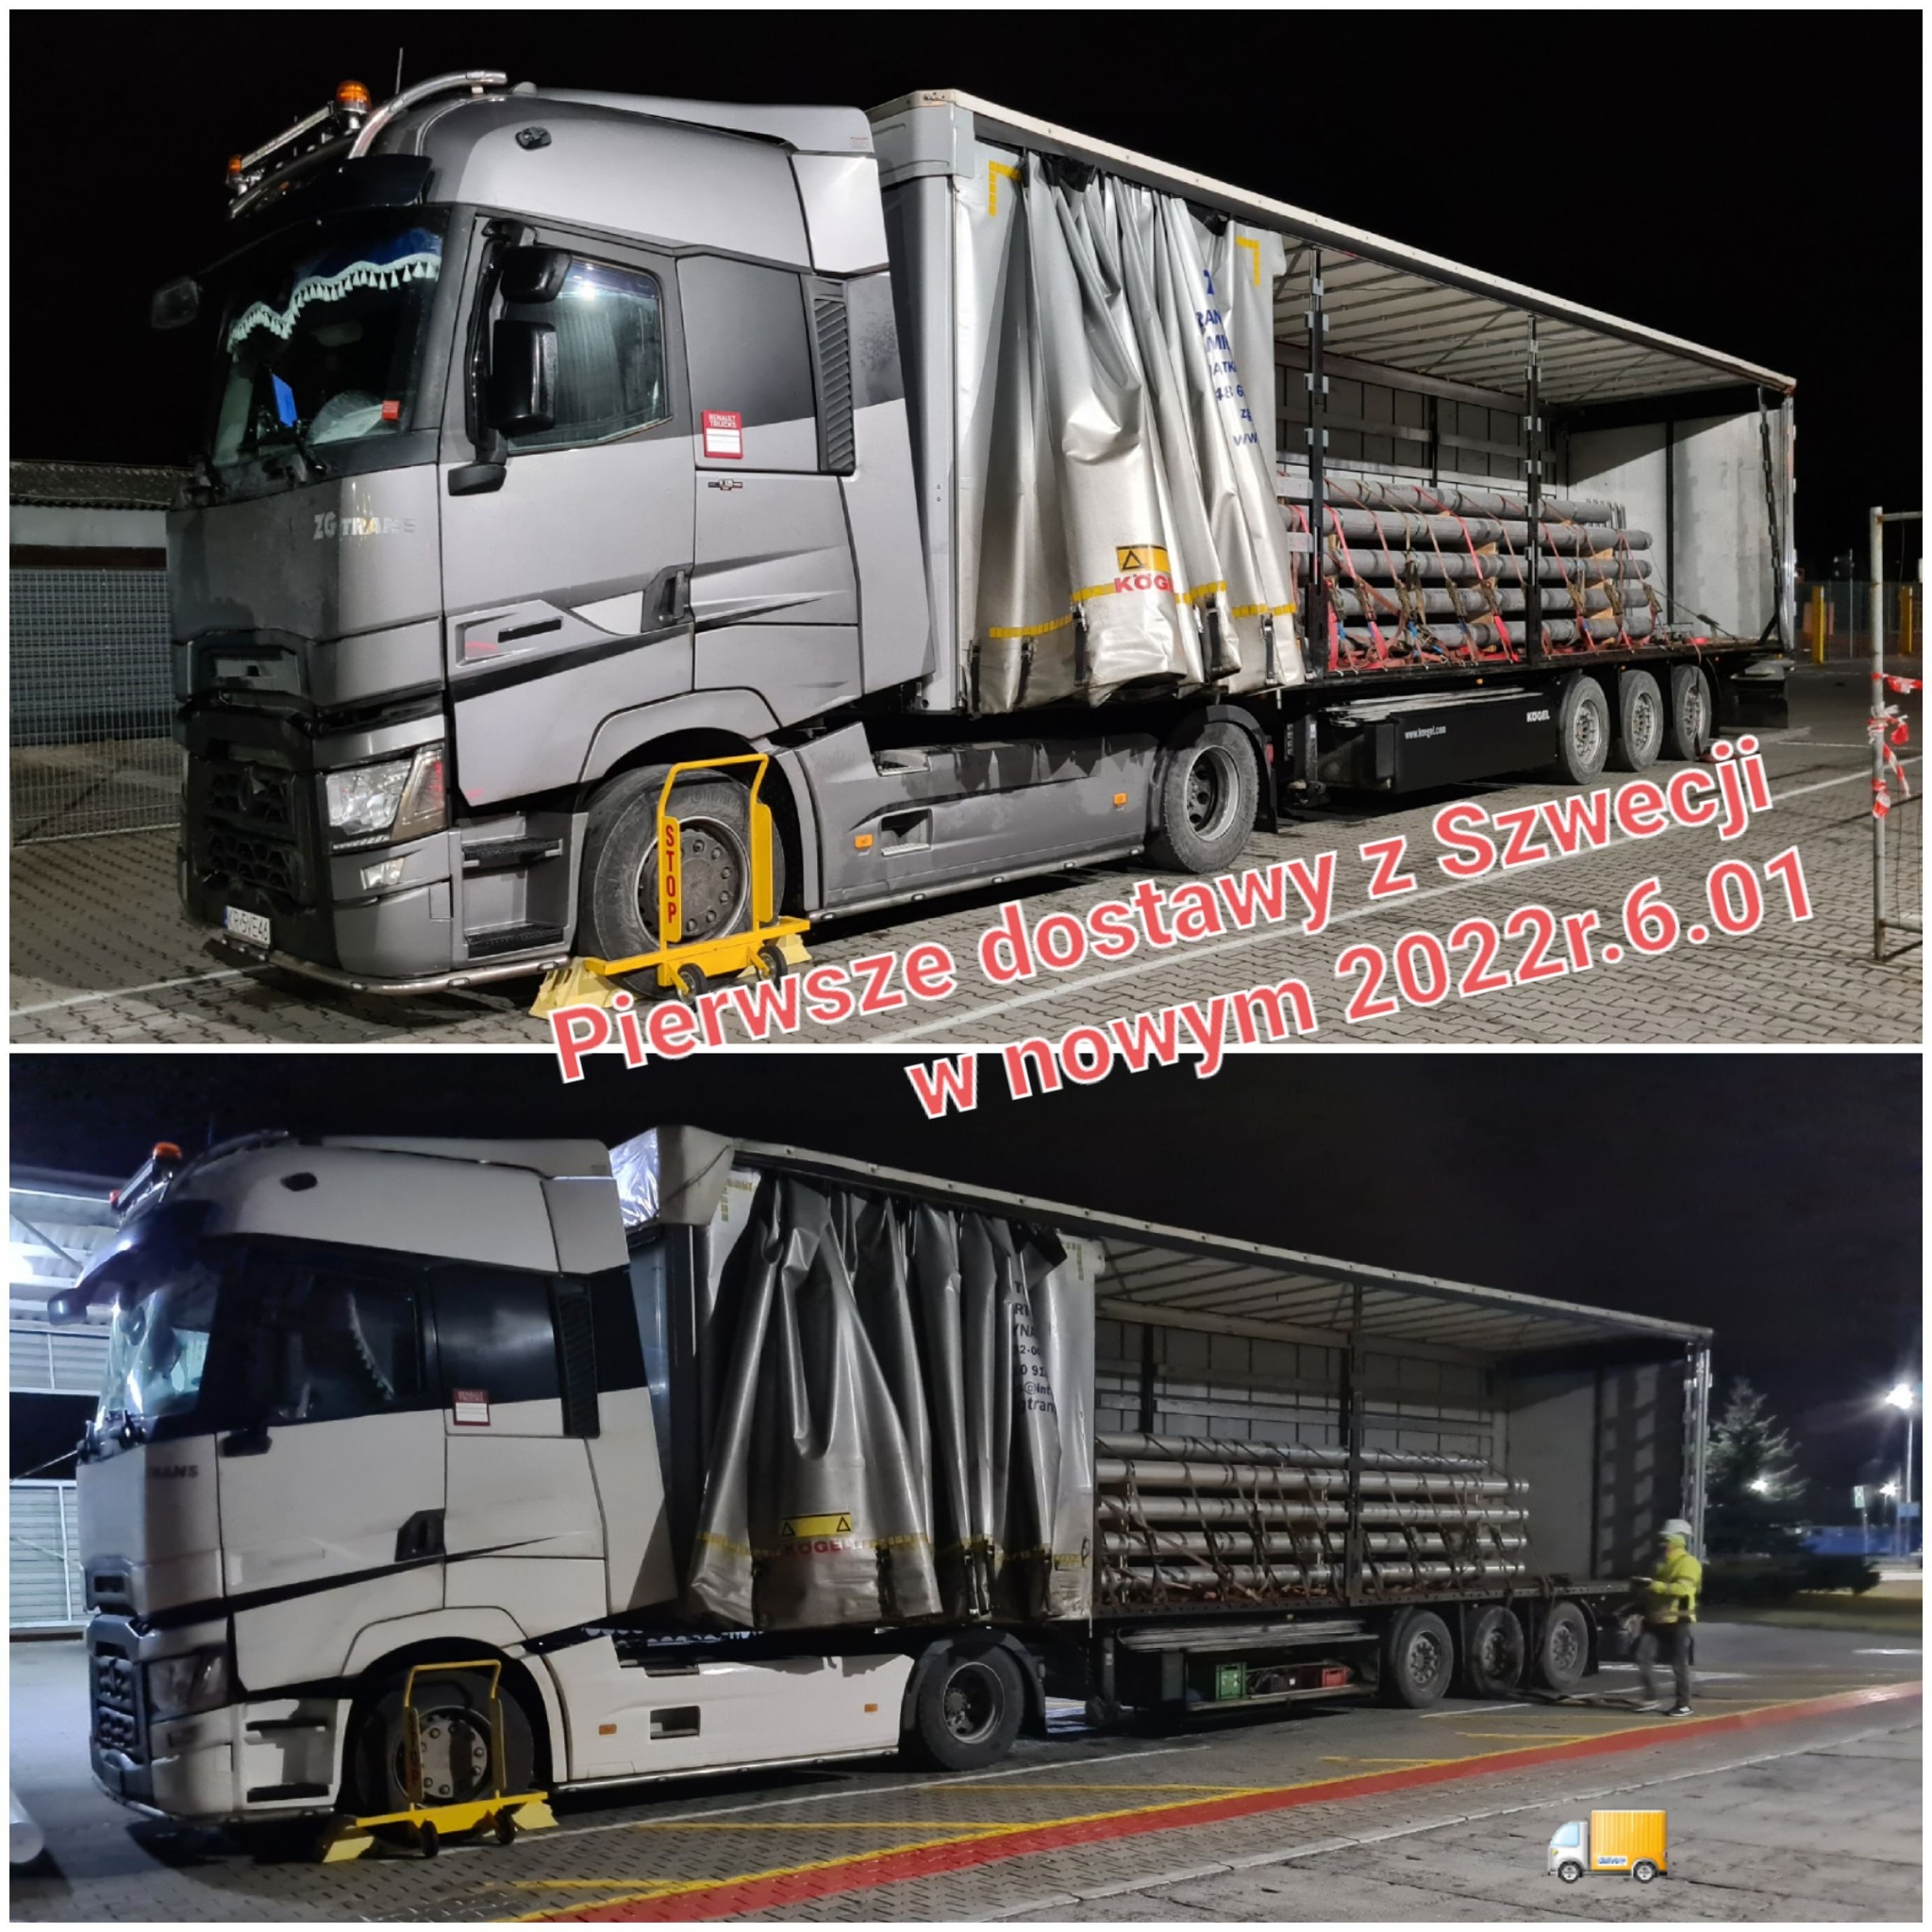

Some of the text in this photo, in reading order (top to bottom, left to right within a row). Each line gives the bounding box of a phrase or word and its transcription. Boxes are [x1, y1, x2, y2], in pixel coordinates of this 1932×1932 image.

[709, 420, 738, 429] TRUCKS
[313, 511, 337, 541] ZG
[665, 824, 677, 924] STOP
